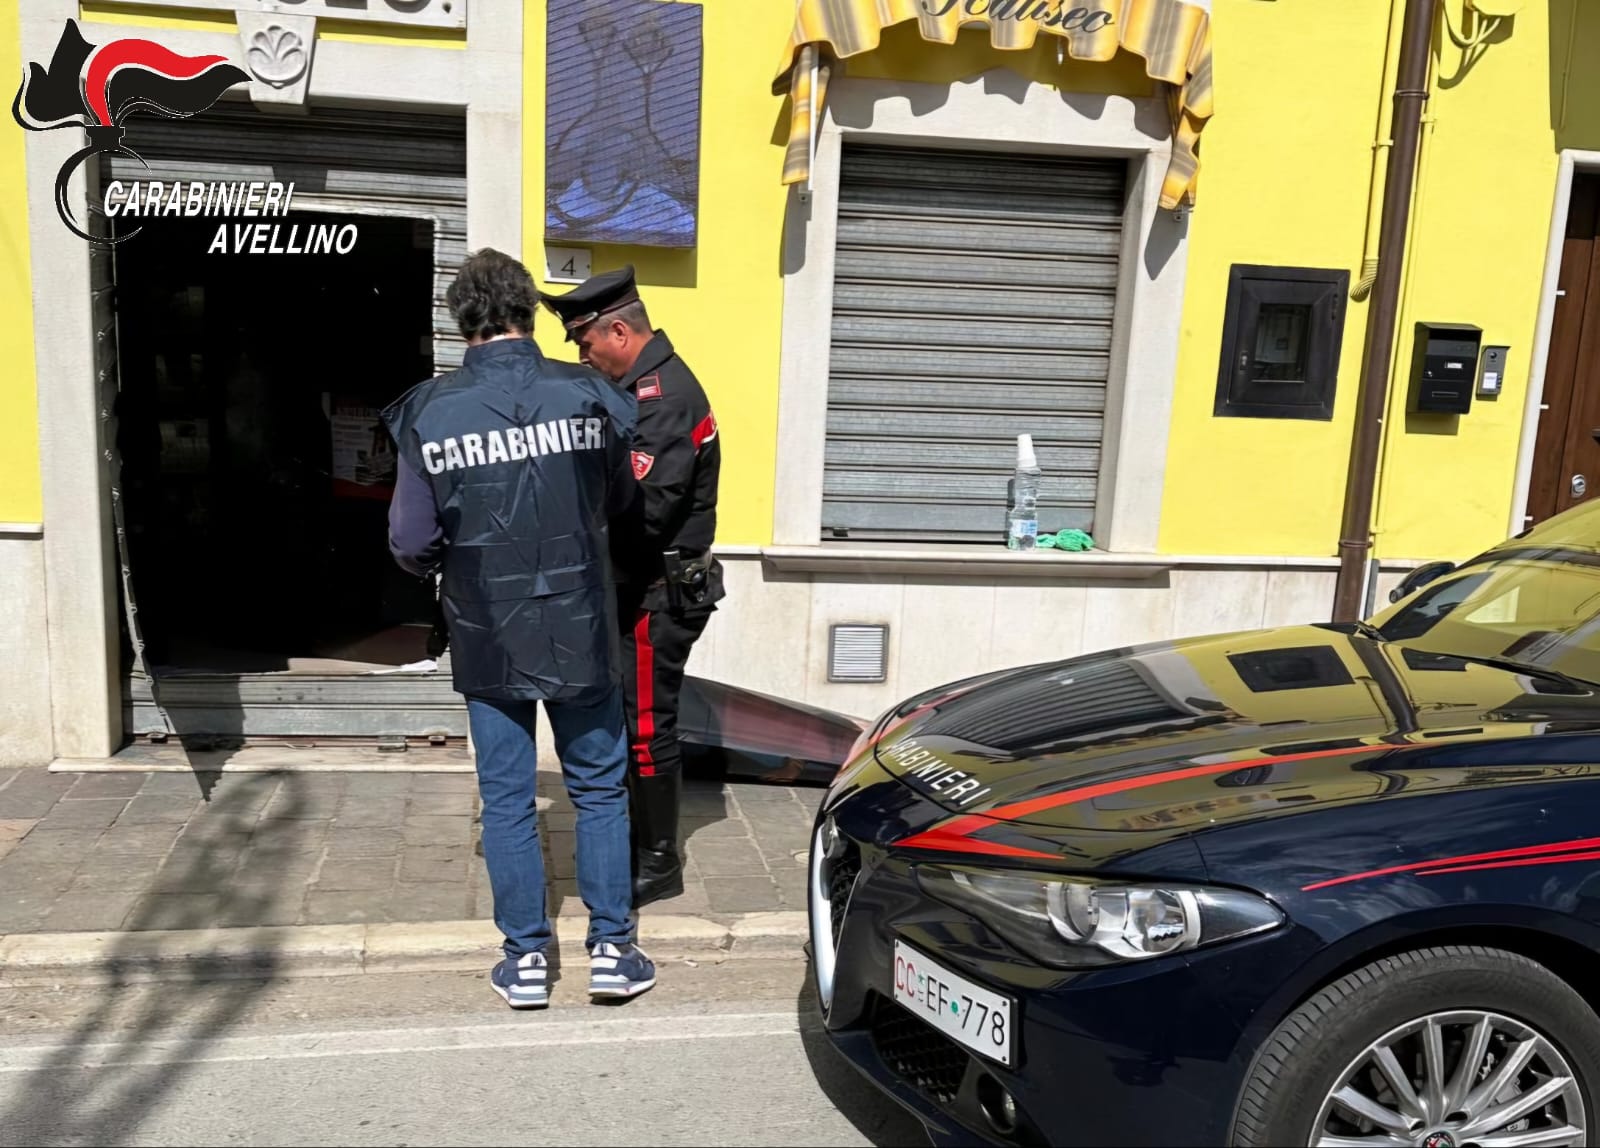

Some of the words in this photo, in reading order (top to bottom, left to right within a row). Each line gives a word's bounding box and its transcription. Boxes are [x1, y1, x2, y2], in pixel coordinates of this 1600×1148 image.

[560, 256, 577, 276] 4
[884, 737, 991, 806] RABINIERI
[896, 955, 915, 998] CC
[927, 975, 950, 1016] EF
[961, 995, 1005, 1046] 778
